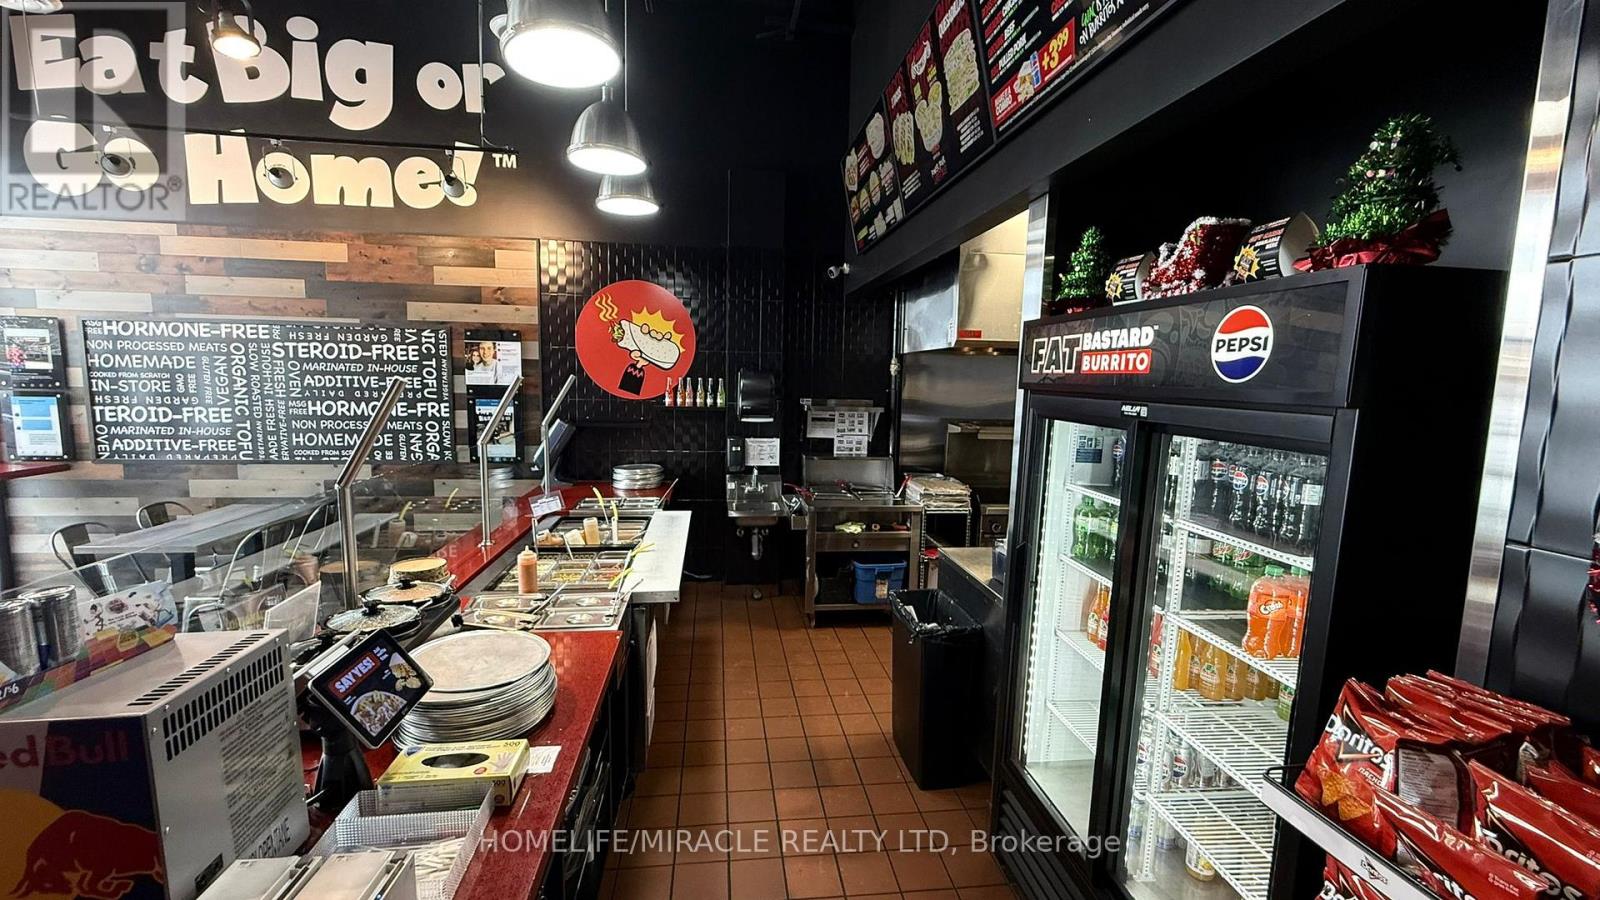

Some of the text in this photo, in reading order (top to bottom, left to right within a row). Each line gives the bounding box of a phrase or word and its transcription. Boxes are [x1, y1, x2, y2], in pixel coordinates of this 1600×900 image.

[9, 13, 506, 131] Eat Big or
[23, 118, 160, 197] Go
[184, 128, 484, 209] Home!
[103, 321, 270, 339] HORMONE-FREE
[289, 332, 388, 342] GARDEN FRESH
[87, 340, 227, 352] NON PROCESSED MEATS
[272, 342, 420, 361] STEROID-FREE
[1031, 326, 1154, 373] FAT BASTARD
[1215, 336, 1269, 352] PEPSI
[88, 353, 196, 369] HOMEMADE
[260, 342, 273, 394] IN-HOUSE
[302, 362, 418, 373] MARINATED IN-HOUSE
[1081, 352, 1149, 371] BURRITO
[91, 379, 171, 392] IN-STORE
[175, 373, 185, 393] GMO
[188, 373, 197, 393] FREE
[202, 356, 213, 405] GLUTEN FREE
[213, 355, 230, 406] VEGAN
[248, 342, 262, 418] SLOW ROASTED
[273, 360, 286, 397] FRESH
[288, 360, 302, 398] OVEN
[304, 375, 422, 388] ADDITIVE-FEE
[422, 358, 437, 399] TOFU
[438, 359, 448, 400] VEGETARIAN
[96, 396, 199, 405] GARDEN FRESH
[229, 342, 253, 460] ORGANIC TOFU
[265, 399, 276, 431] FRESH
[292, 420, 423, 430] NON PROCESS MEATS
[95, 424, 110, 460] OVEN
[110, 426, 232, 436] MARINATED IN-HOUSE
[292, 433, 393, 446] HOMEMDE
[442, 421, 451, 447] SLOW
[112, 439, 237, 451] ADDITIVE-FREE
[334, 656, 376, 693] SAY YES!
[45, 729, 128, 768] Bull
